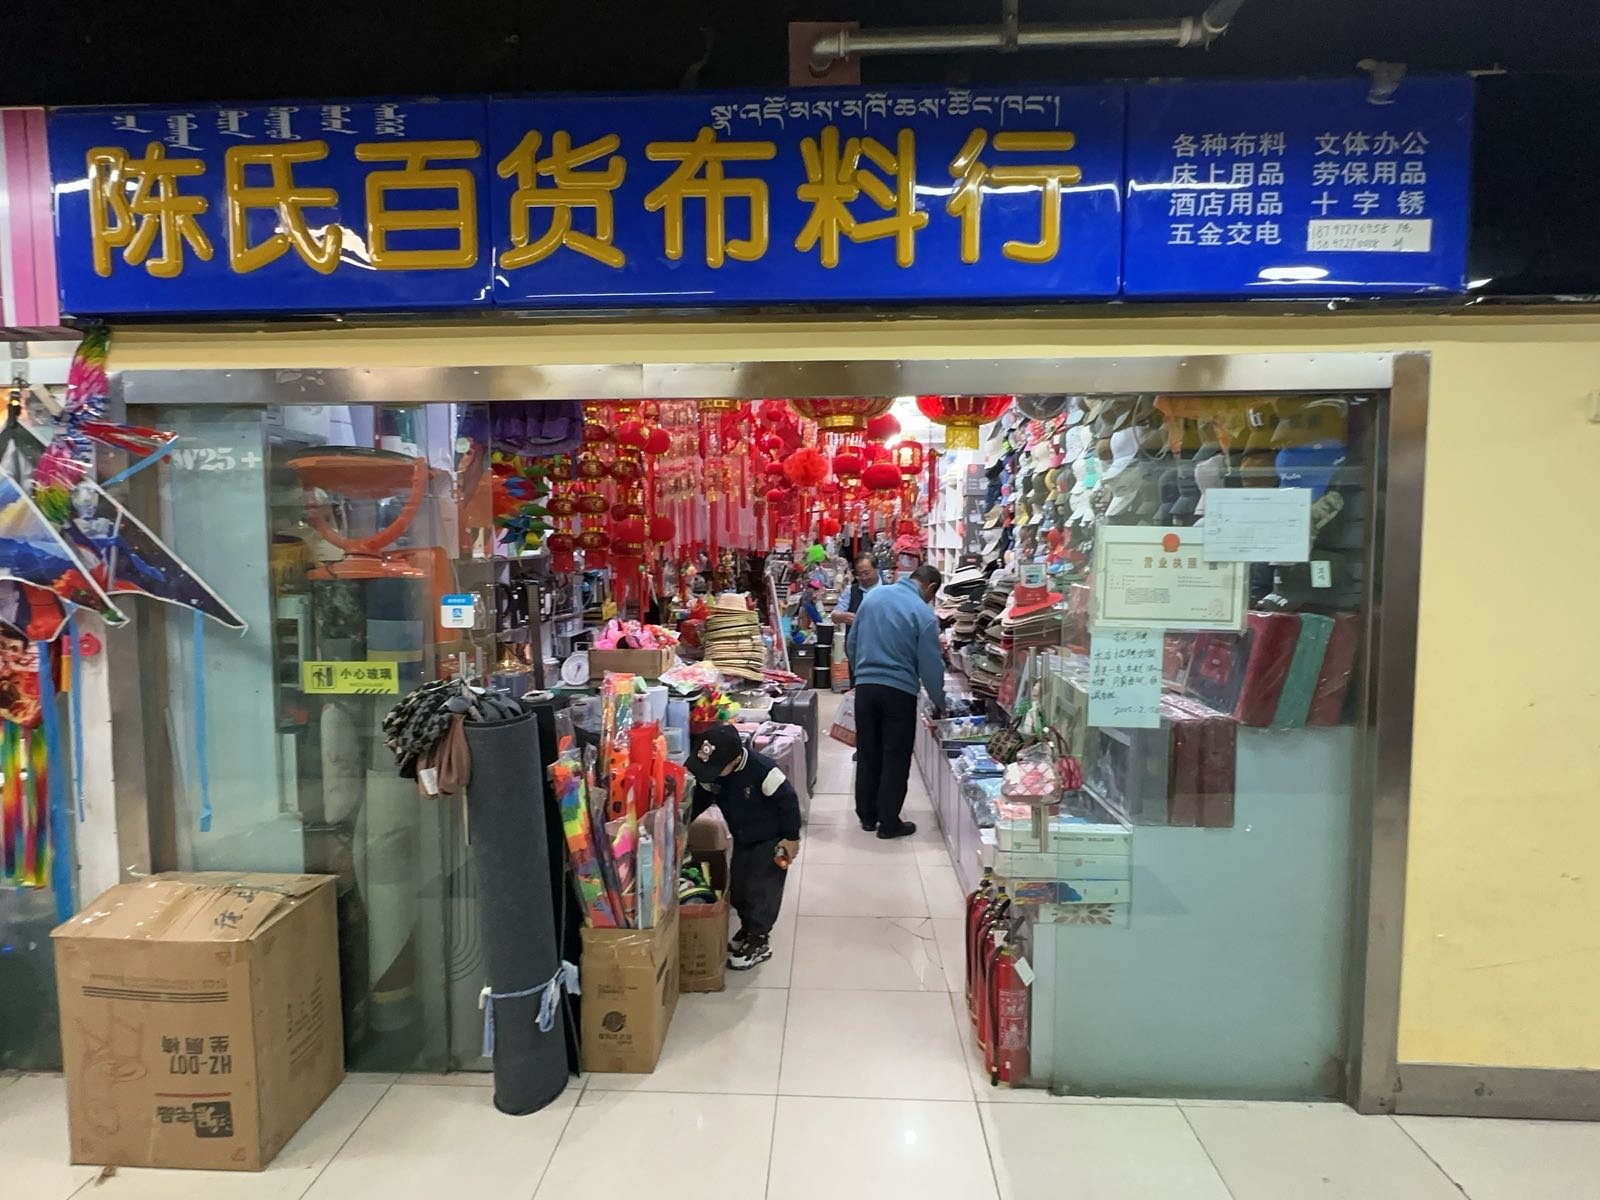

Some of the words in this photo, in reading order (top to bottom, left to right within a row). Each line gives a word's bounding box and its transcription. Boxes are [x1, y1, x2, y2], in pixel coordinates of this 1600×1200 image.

[1172, 131, 1287, 158] 各种布料
[1314, 131, 1430, 156] 文体办公
[1170, 162, 1286, 188] 床上用品
[1311, 161, 1428, 186] 劳保用品
[87, 126, 1082, 278] 陈氏百货布料行
[1168, 192, 1284, 217] 酒店用品
[1167, 221, 1283, 247] 五金交电
[1143, 556, 1198, 569] 营业执照
[340, 667, 392, 680] 小心玻璃
